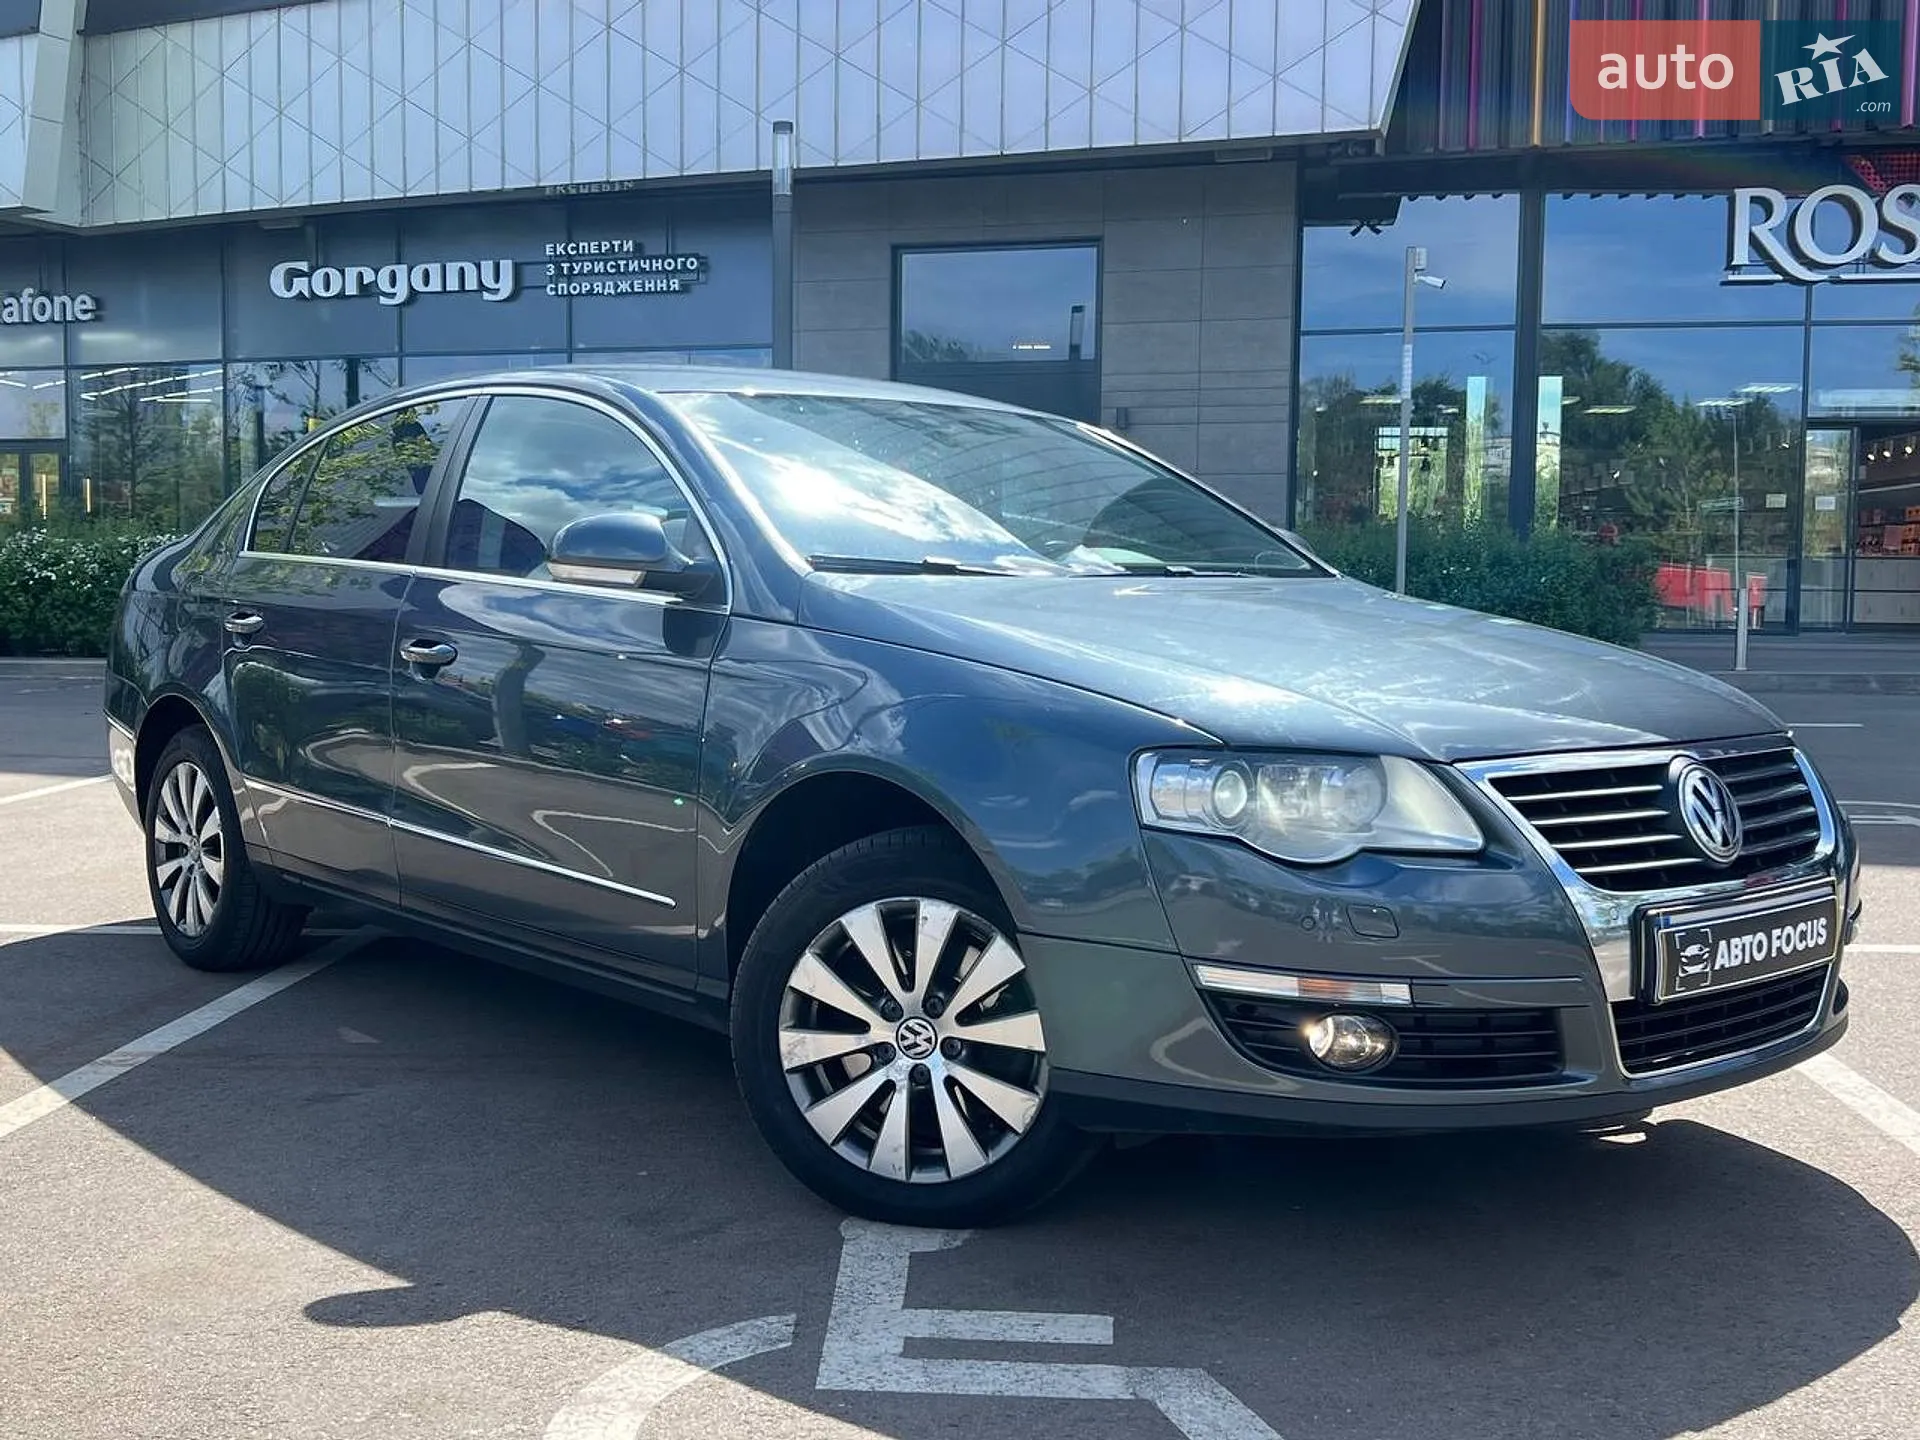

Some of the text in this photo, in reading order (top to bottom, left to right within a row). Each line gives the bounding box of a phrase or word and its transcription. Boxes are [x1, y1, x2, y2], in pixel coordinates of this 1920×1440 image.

[545, 240, 634, 256] ЕКСПЕРТИ
[1731, 184, 1920, 282] ROS
[561, 257, 698, 276] ТУРИСТИЧНОГО
[269, 259, 514, 306] Gorgany
[546, 279, 680, 297] СПОРЯДЖЕННЯ
[1771, 917, 1827, 958] FOCUS
